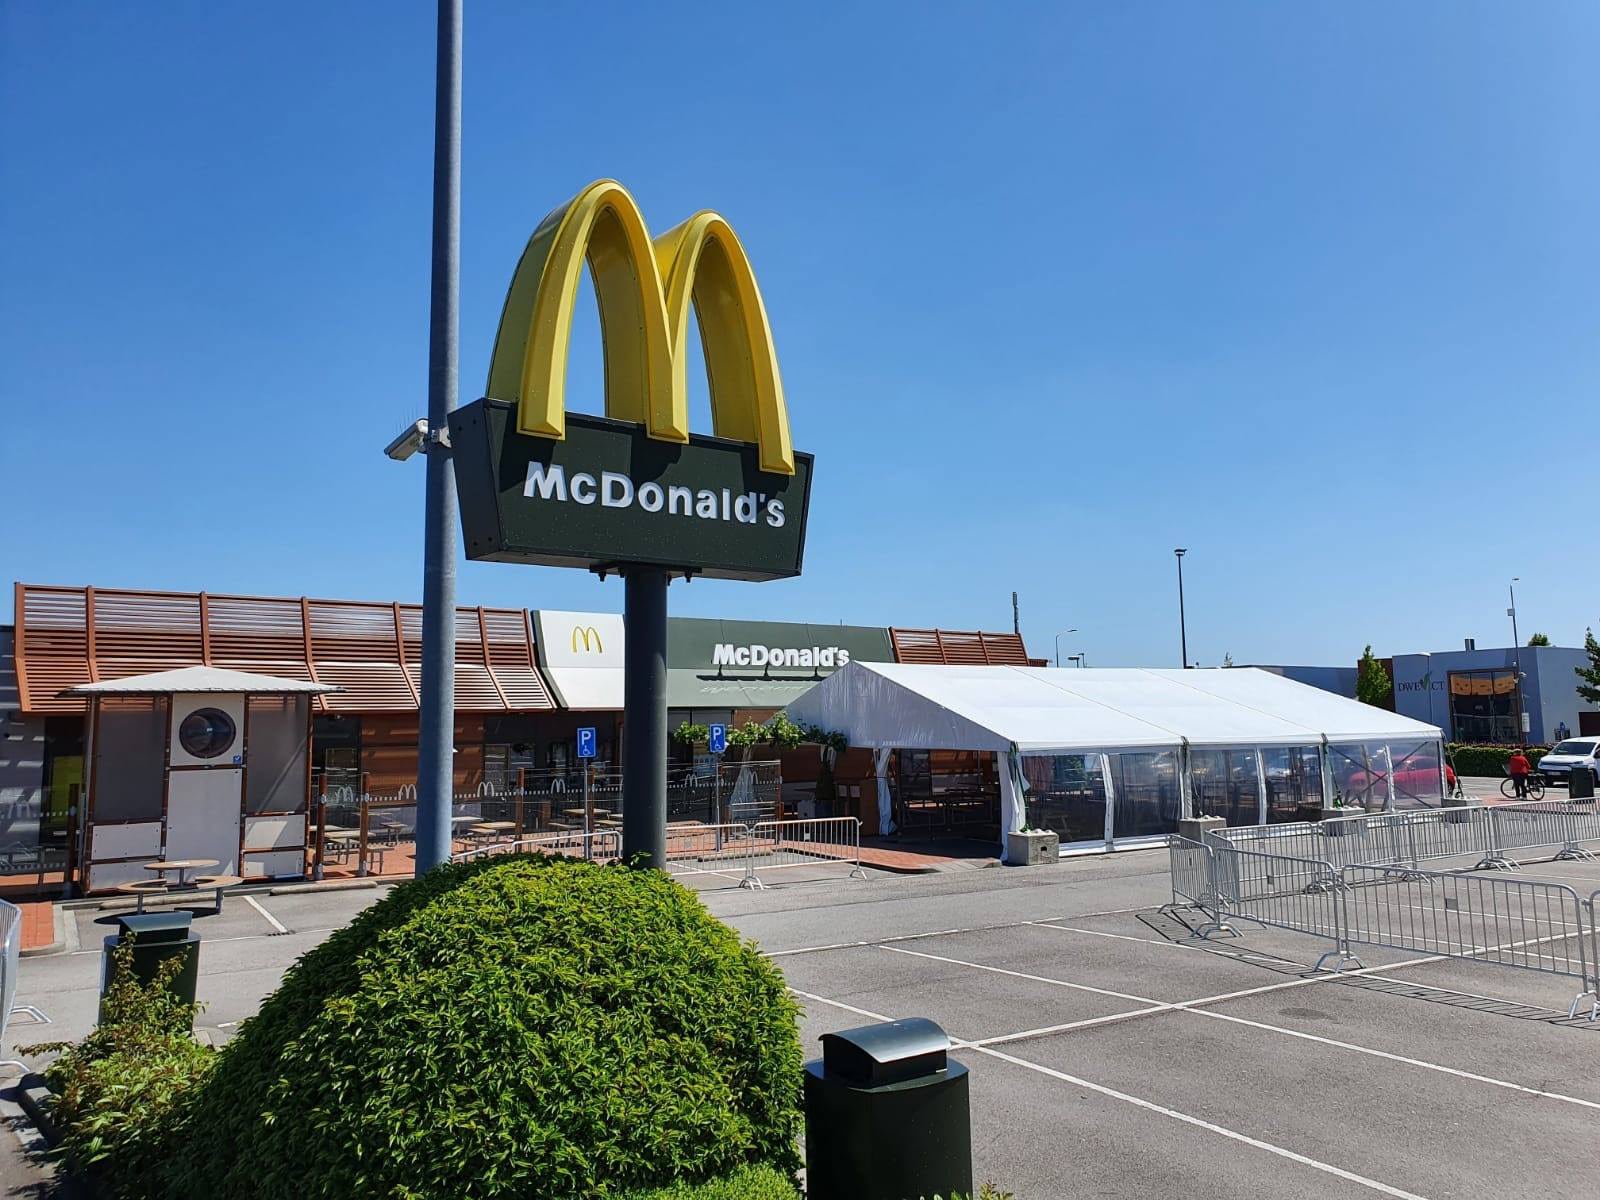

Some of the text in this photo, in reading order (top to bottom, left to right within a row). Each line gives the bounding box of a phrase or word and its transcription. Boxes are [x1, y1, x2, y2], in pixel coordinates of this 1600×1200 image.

[523, 460, 787, 528] McDonald's
[713, 643, 850, 667] McDonald's
[581, 730, 592, 746] P
[713, 726, 722, 741] P
